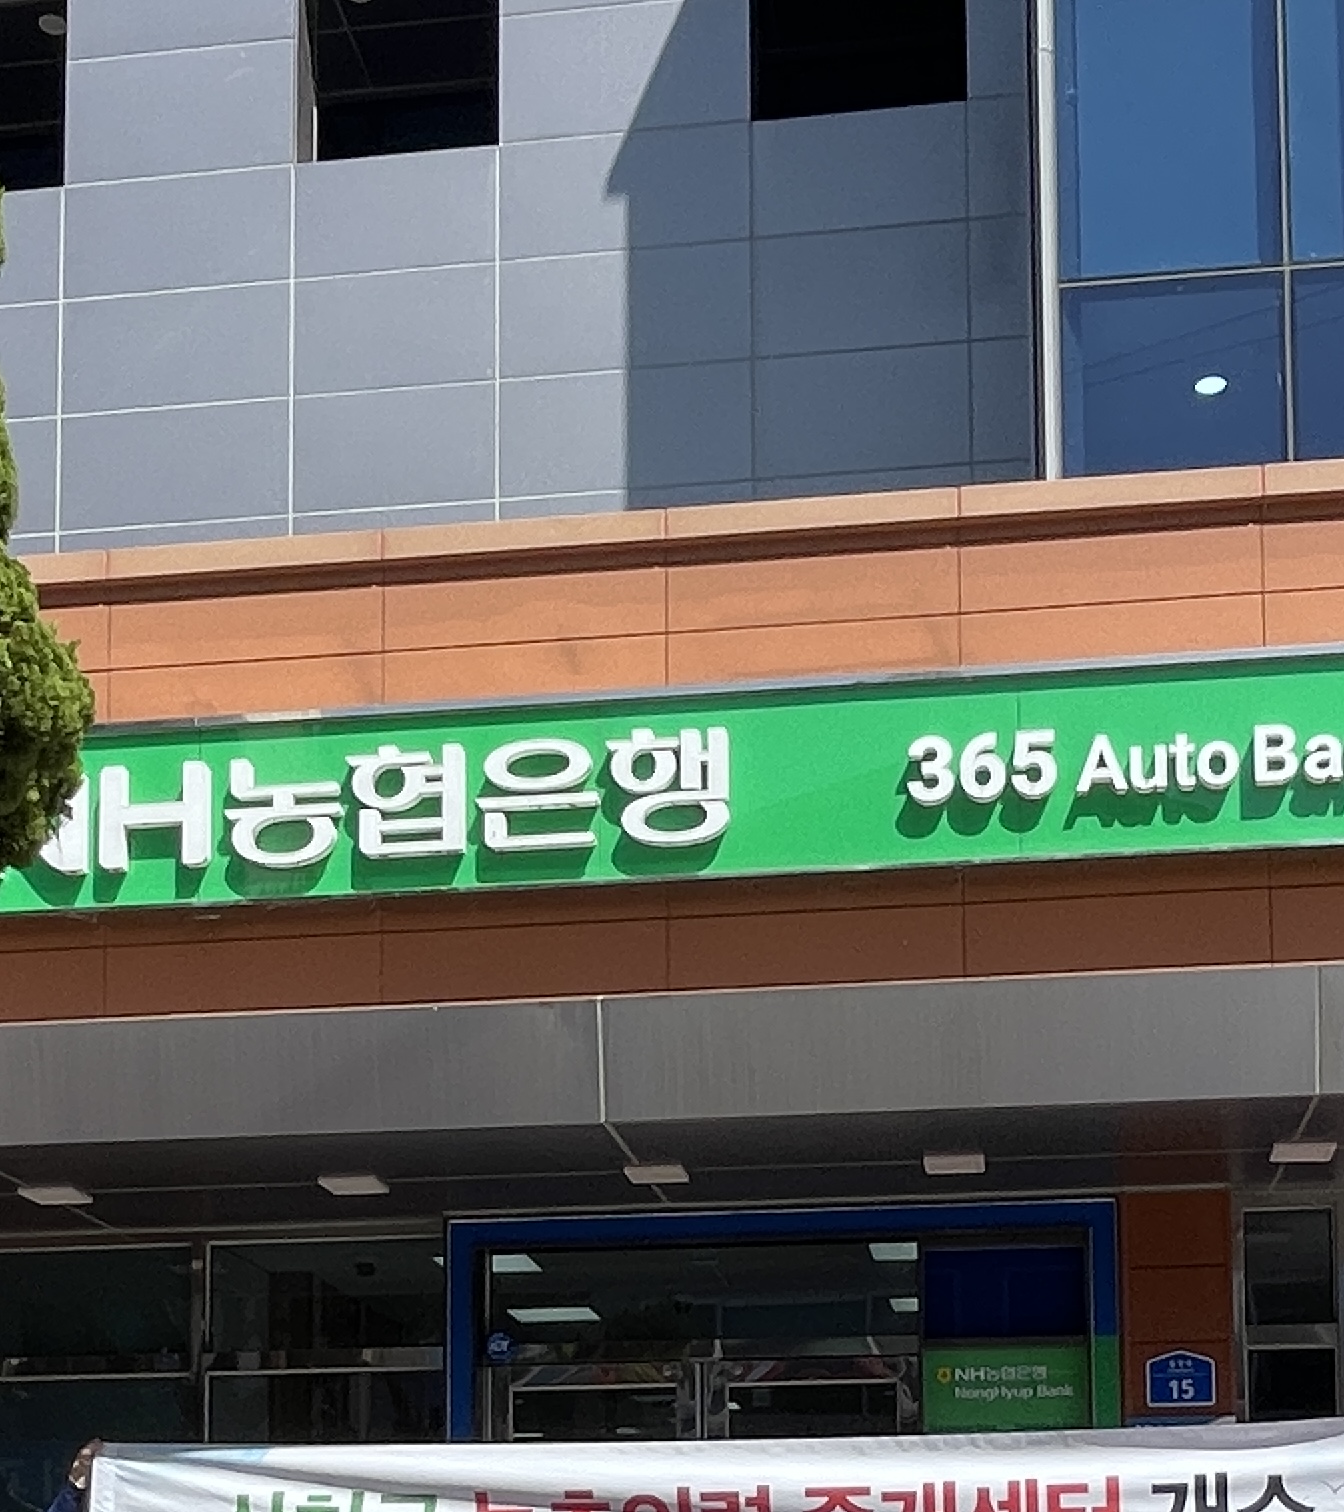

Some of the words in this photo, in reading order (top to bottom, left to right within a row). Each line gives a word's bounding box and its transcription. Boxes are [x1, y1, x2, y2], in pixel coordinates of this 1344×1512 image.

[905, 728, 1058, 806] 365
[1075, 733, 1239, 797] Auto
[1168, 1378, 1196, 1400] 15
